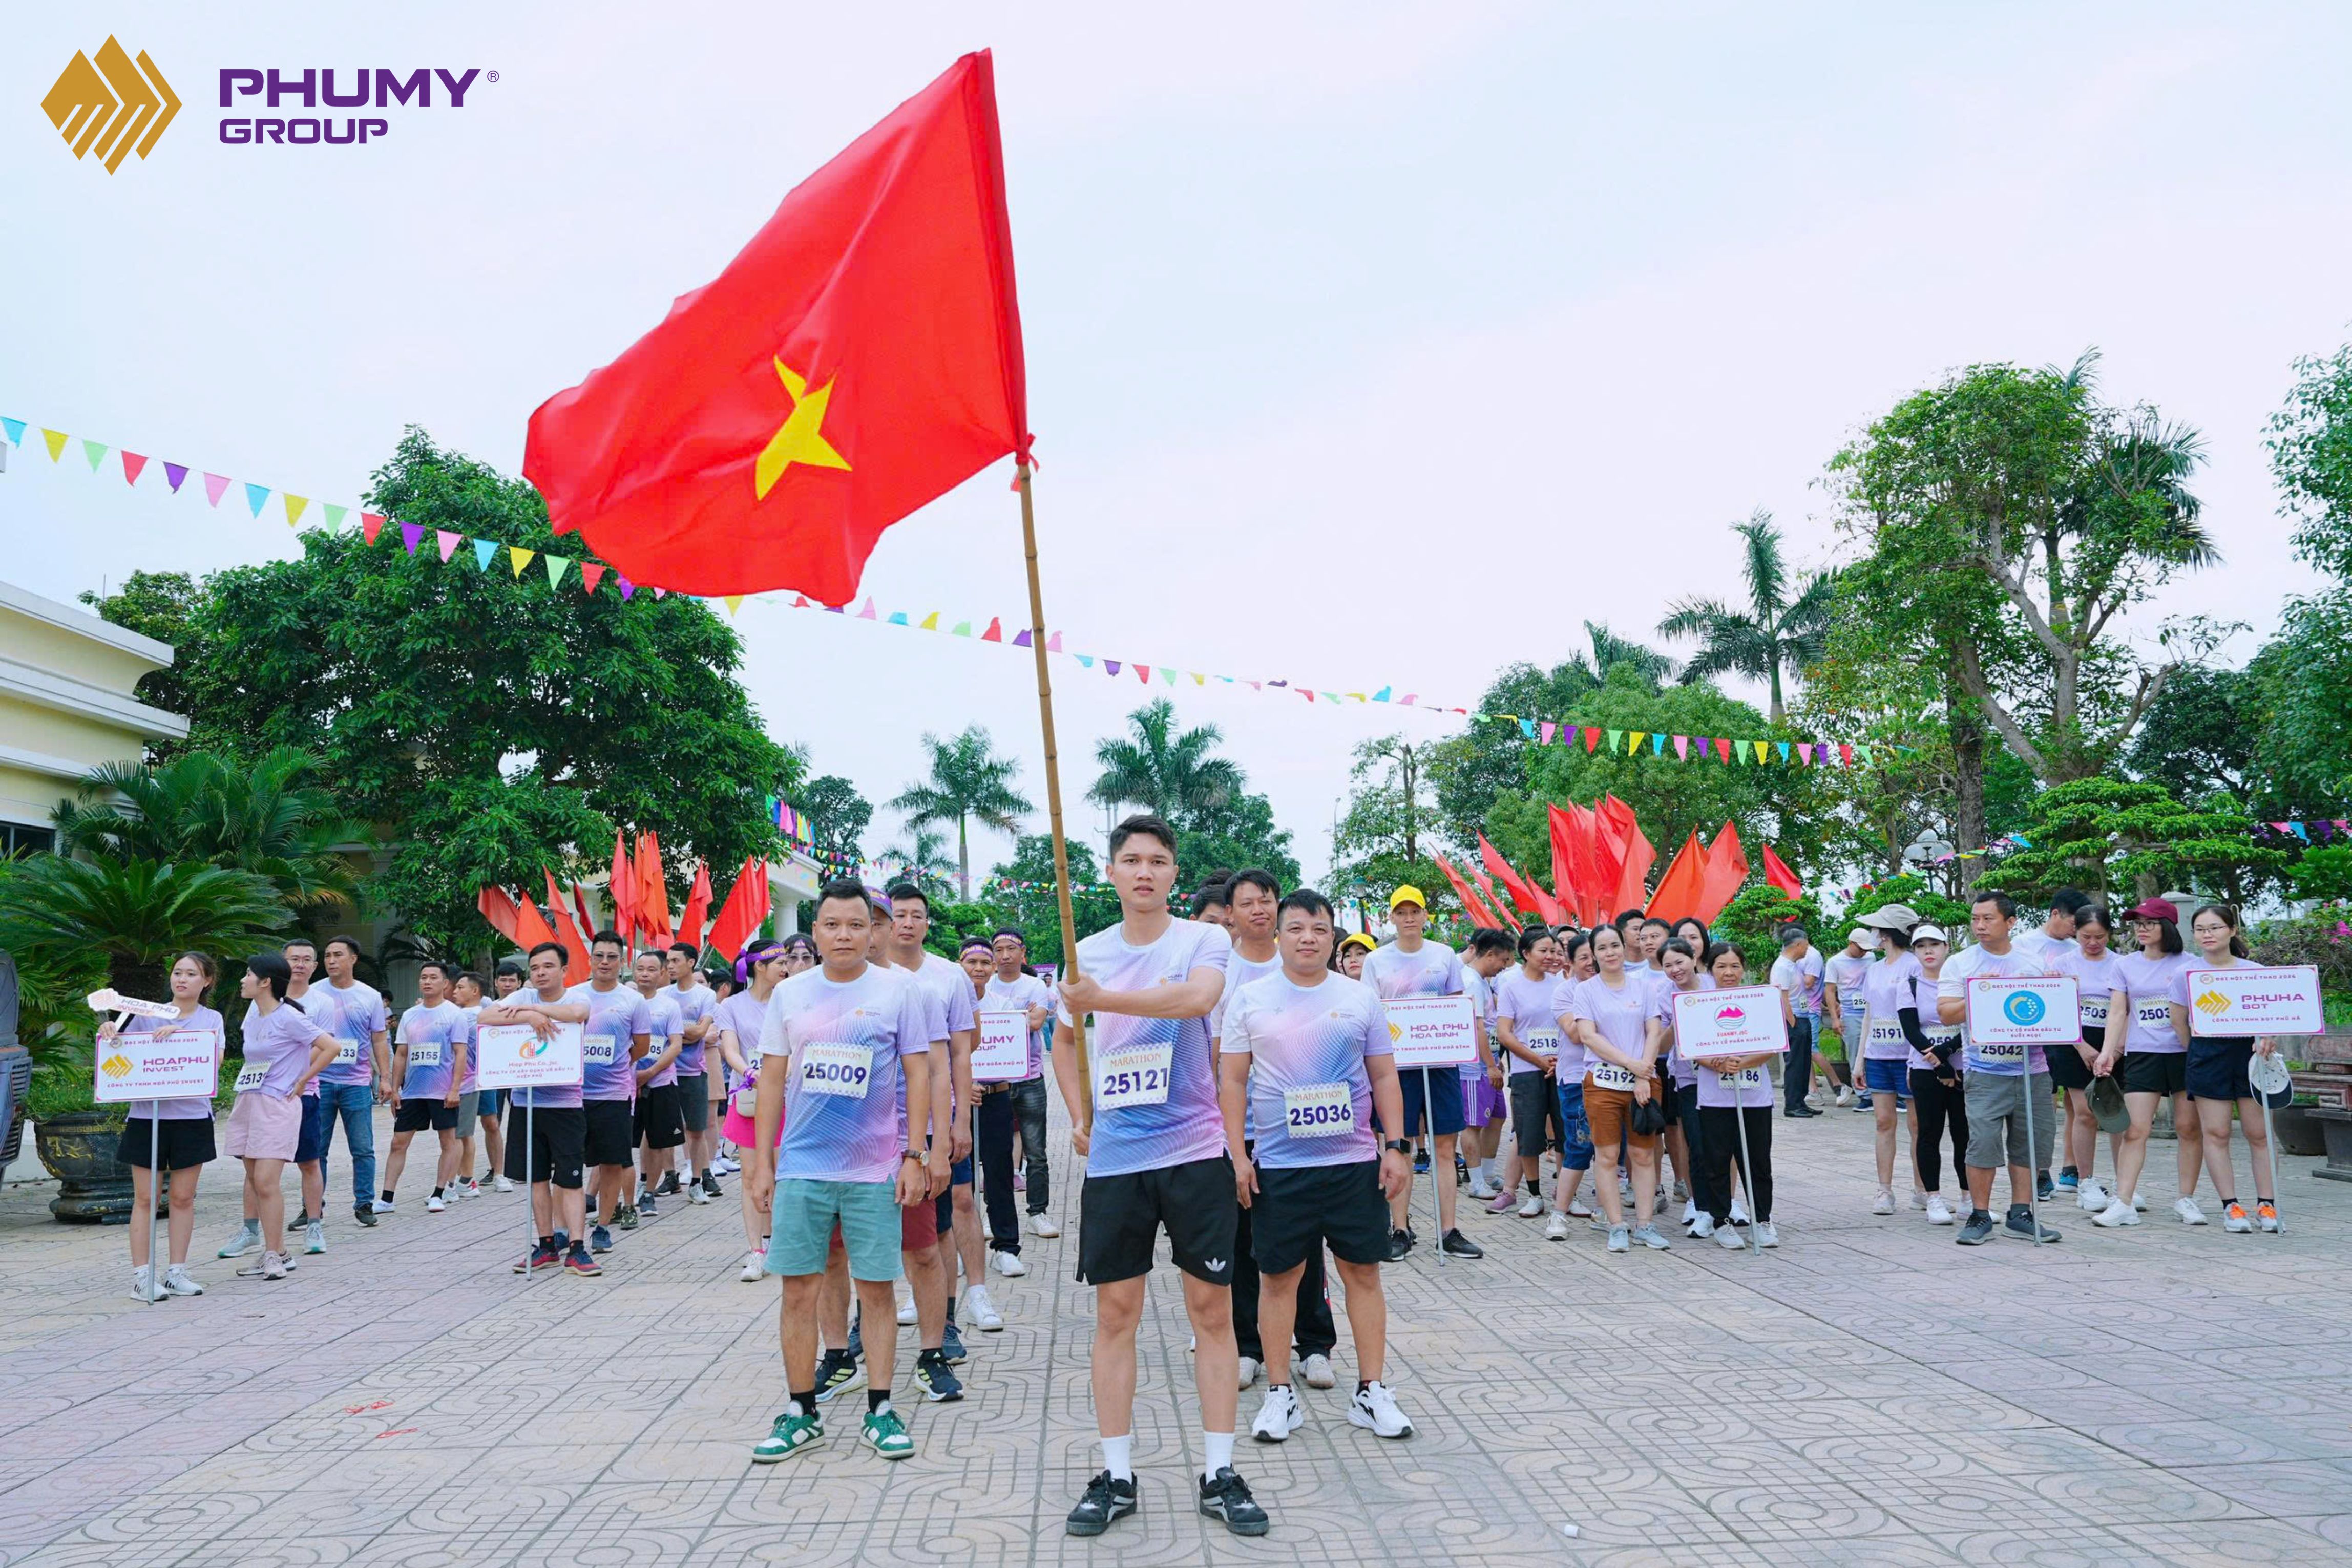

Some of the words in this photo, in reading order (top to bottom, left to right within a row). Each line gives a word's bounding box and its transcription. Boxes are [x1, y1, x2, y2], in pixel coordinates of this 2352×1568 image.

[2241, 994, 2304, 1002] PHUHA
[121, 999, 147, 1008] HOA
[152, 1005, 177, 1014] PHU
[1873, 1028, 1902, 1039] 25191
[1530, 1038, 1559, 1048] 2518
[812, 1049, 861, 1060] MARATHON
[1981, 1045, 2023, 1055] 25042
[143, 1056, 209, 1066] HOAPHU
[411, 1051, 438, 1061] 25155
[1110, 1053, 1161, 1068] MARATHON
[804, 1063, 866, 1084] 25009
[1595, 1069, 1635, 1083] 25192
[1104, 1067, 1168, 1095] 25121
[1295, 1091, 1342, 1101] MARATHON
[1290, 1104, 1351, 1126] 25036
